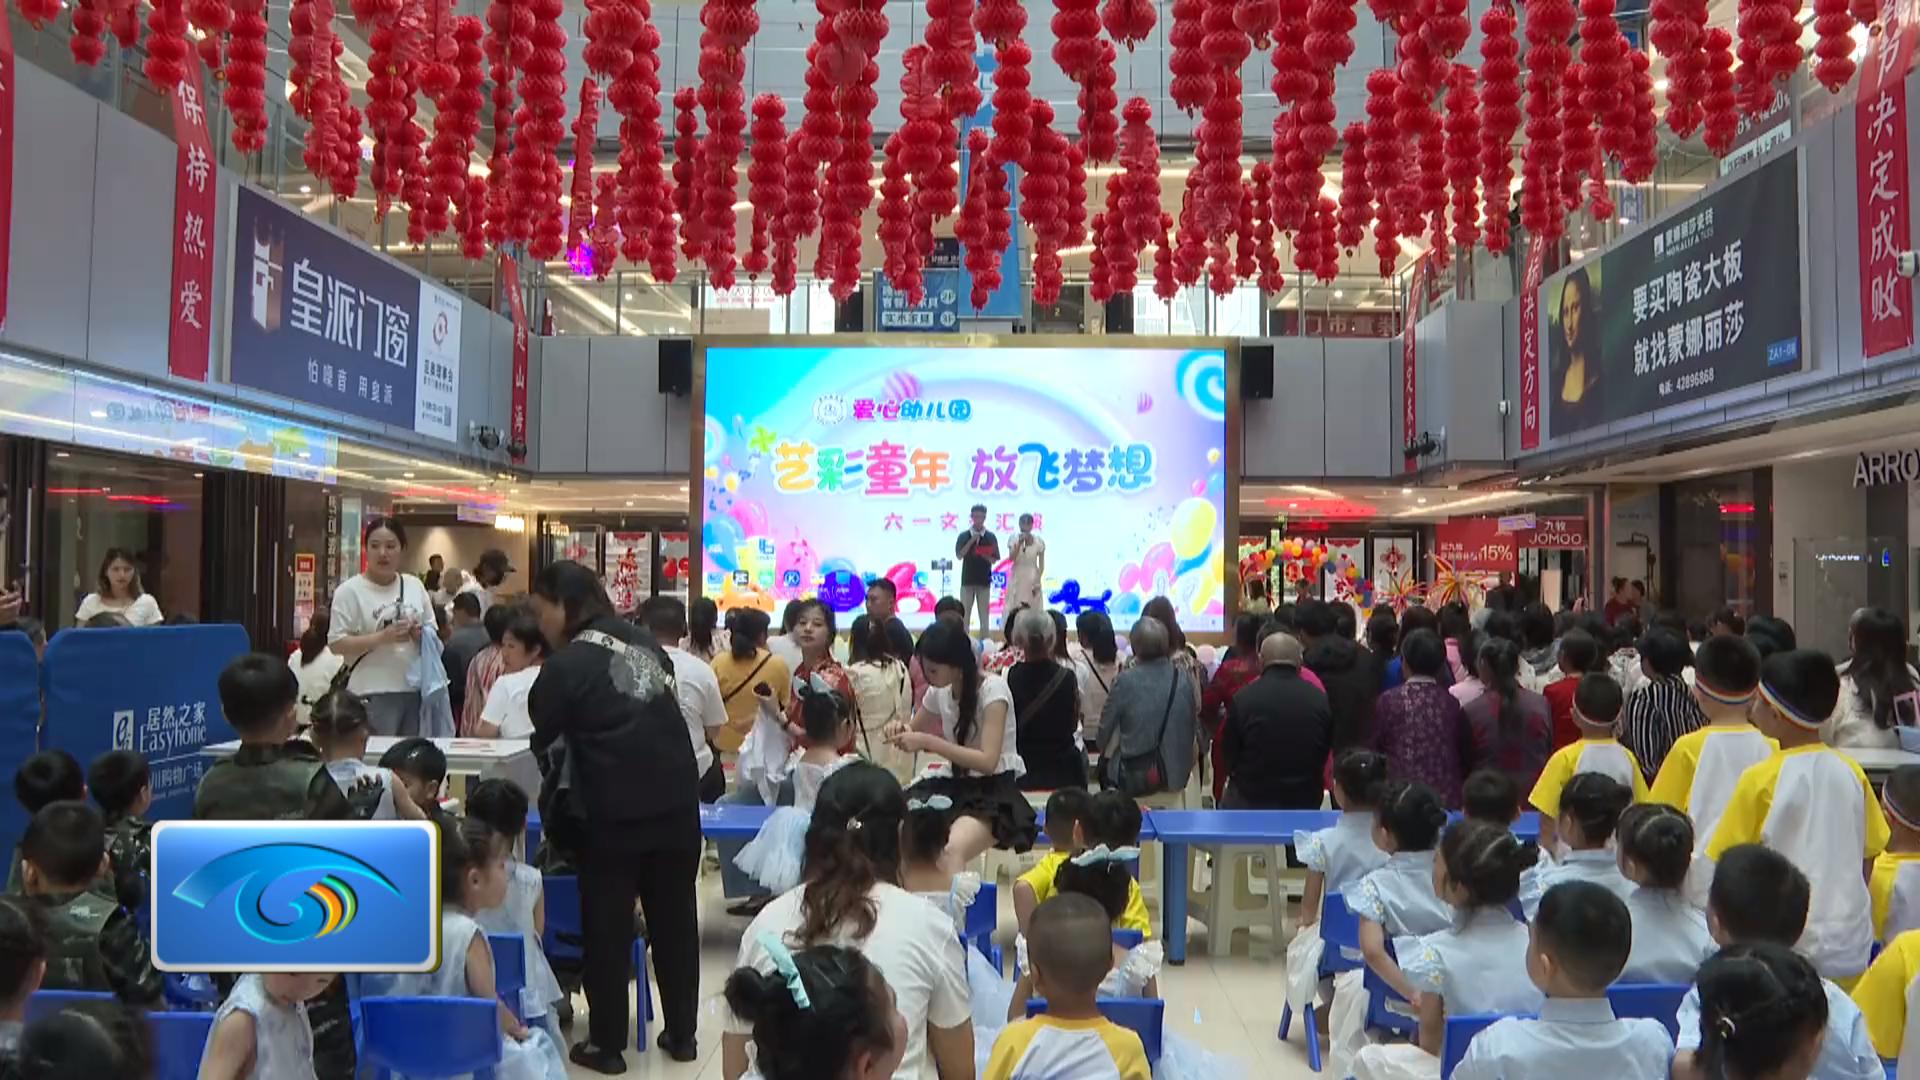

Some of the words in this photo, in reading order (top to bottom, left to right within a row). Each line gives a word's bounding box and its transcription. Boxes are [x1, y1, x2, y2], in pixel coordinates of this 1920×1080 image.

[177, 79, 210, 330] 保持热爱
[1633, 239, 1743, 324] 要买陶瓷大板
[290, 257, 410, 368] 皇派门窗
[1633, 299, 1744, 376] 就找蒙娜丽莎
[853, 398, 972, 421] 爱心幼儿园
[775, 439, 951, 495] 艺彩童年
[971, 442, 1152, 492] 放飞梦想
[1853, 449, 1920, 489] ARRO
[884, 511, 1043, 532] 六一文汇
[1544, 521, 1567, 533] 九牧
[1480, 544, 1513, 561] 15%
[1529, 533, 1582, 546] JOMOO
[147, 701, 206, 731] 居然之家
[139, 719, 207, 758] Easyhome
[151, 761, 204, 789] 川购物广场
